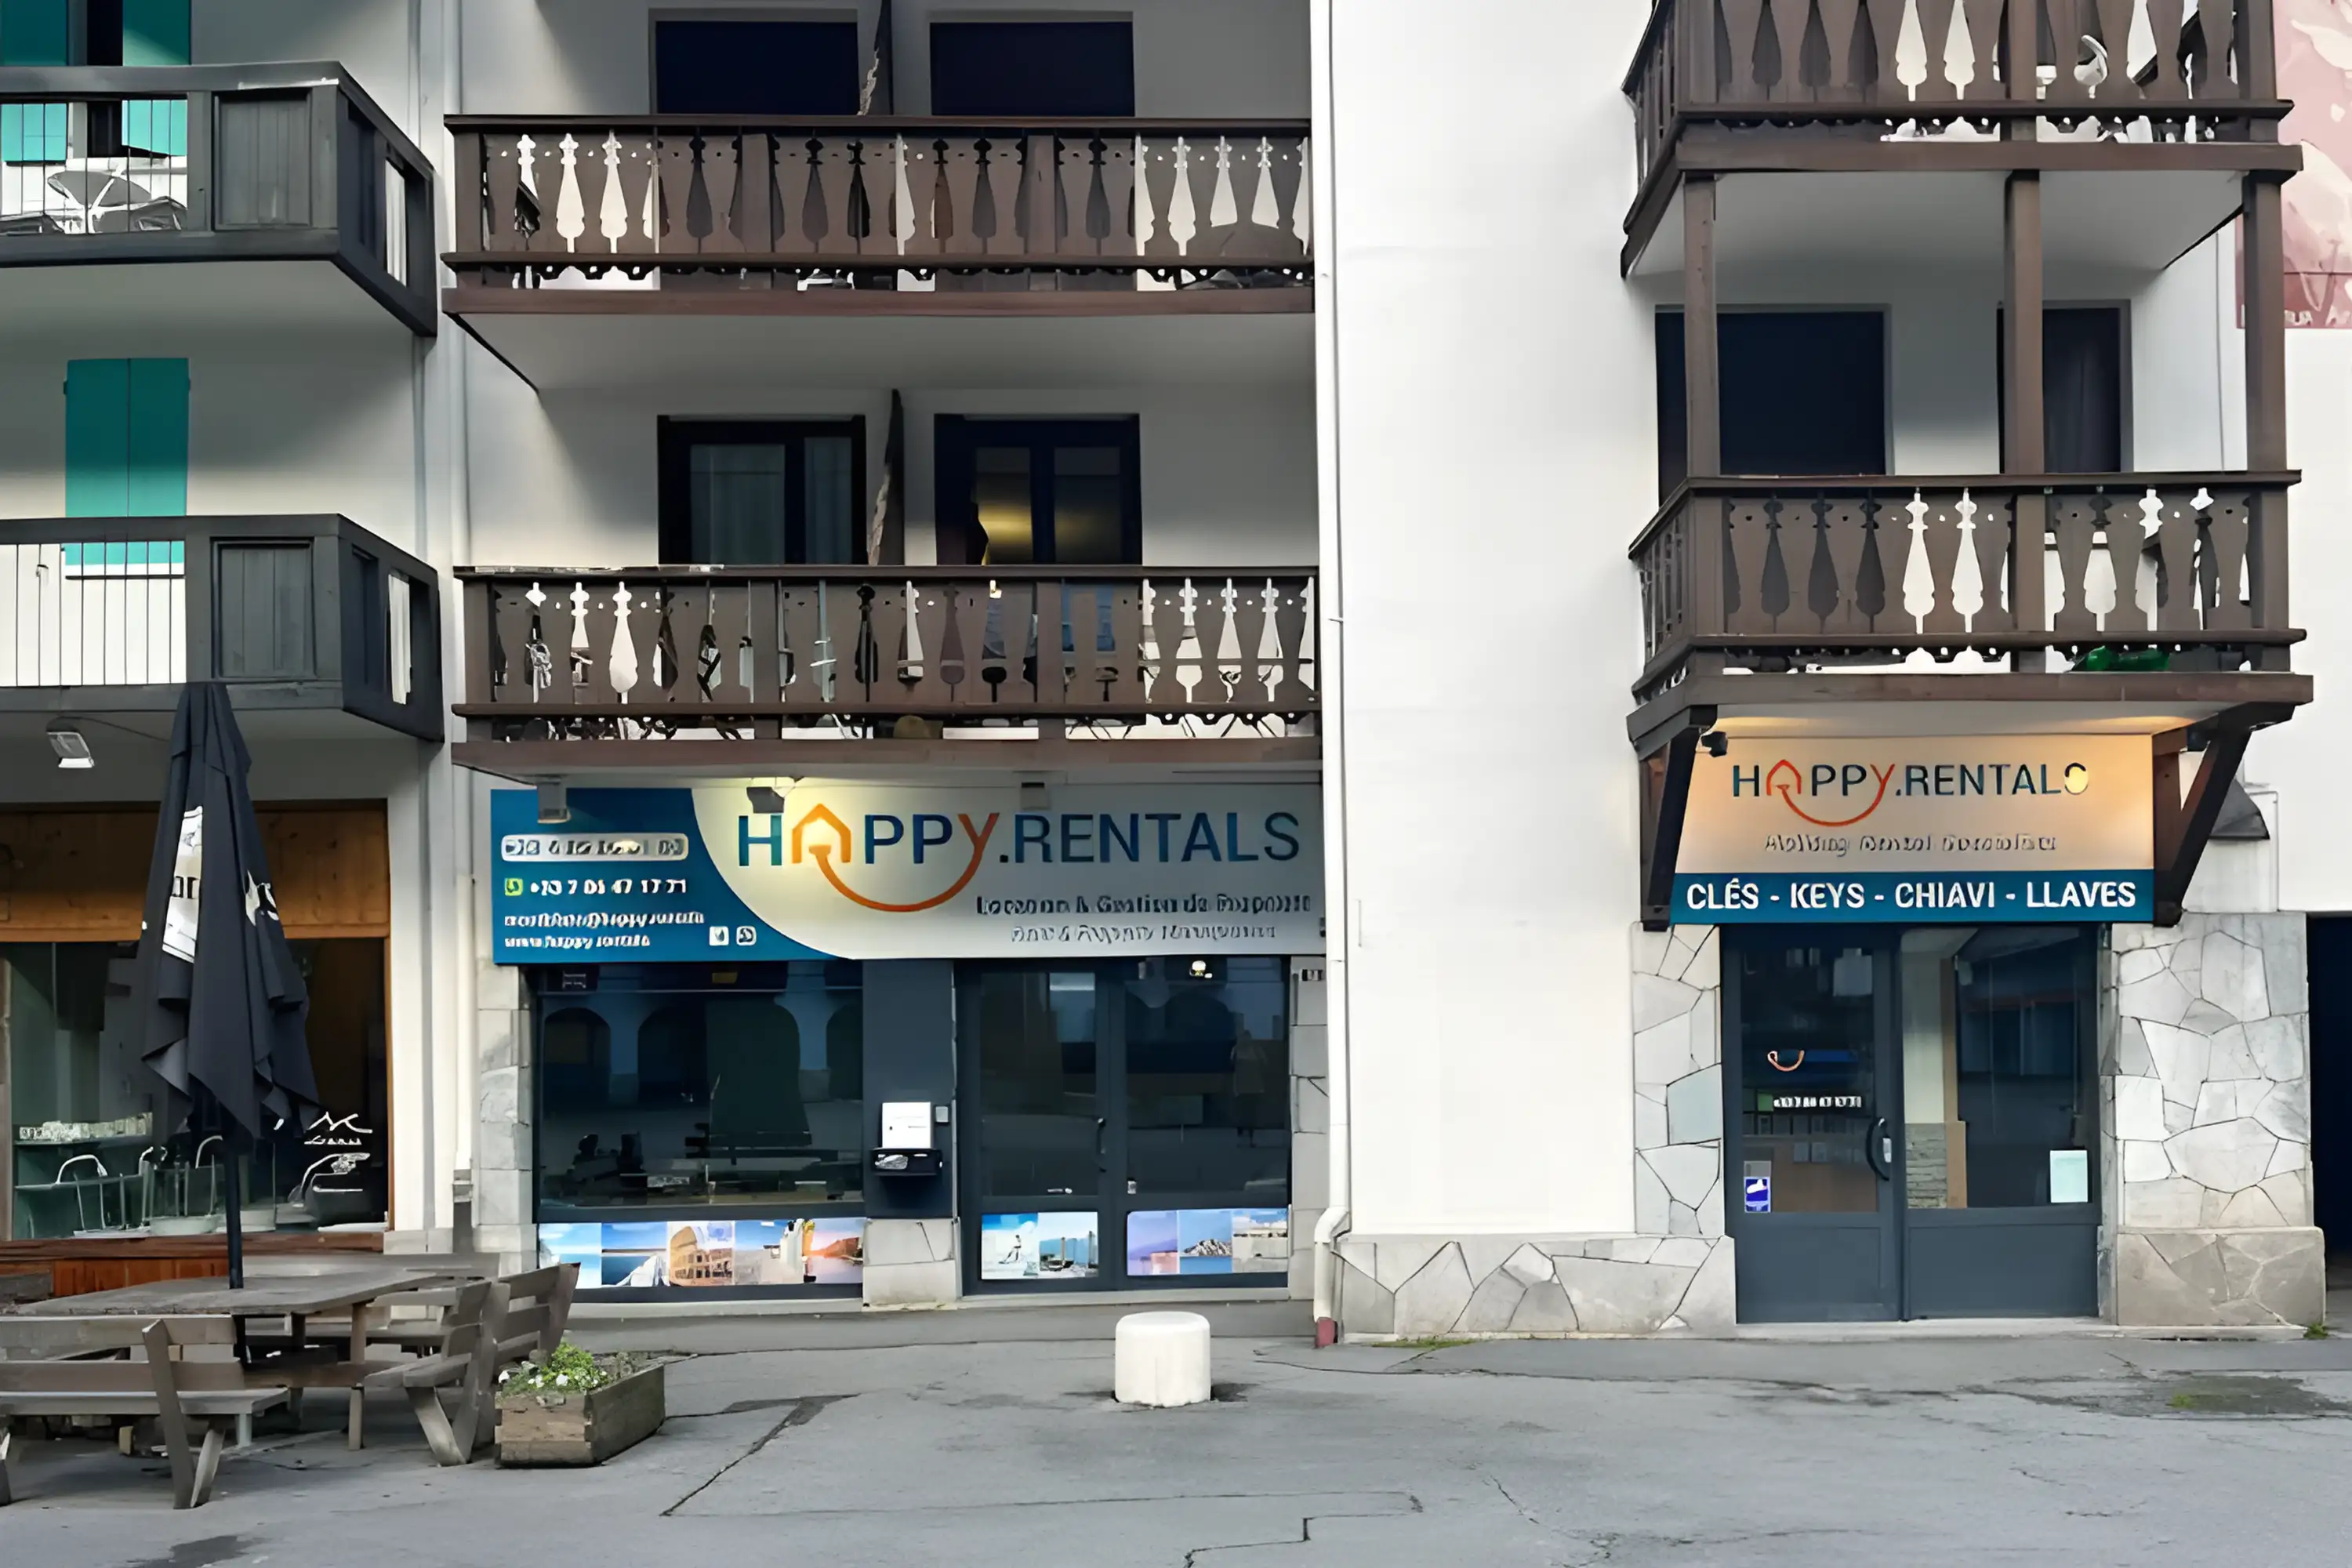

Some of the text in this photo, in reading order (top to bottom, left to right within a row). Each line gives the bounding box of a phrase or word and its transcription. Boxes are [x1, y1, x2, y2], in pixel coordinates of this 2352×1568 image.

[737, 804, 1300, 894] HAPPY.RENTALS
[1686, 877, 1759, 909] CLÉS
[1791, 882, 1865, 909] KEYS
[1895, 881, 1994, 909] CHIAVI
[2027, 880, 2136, 908] LLAVES
